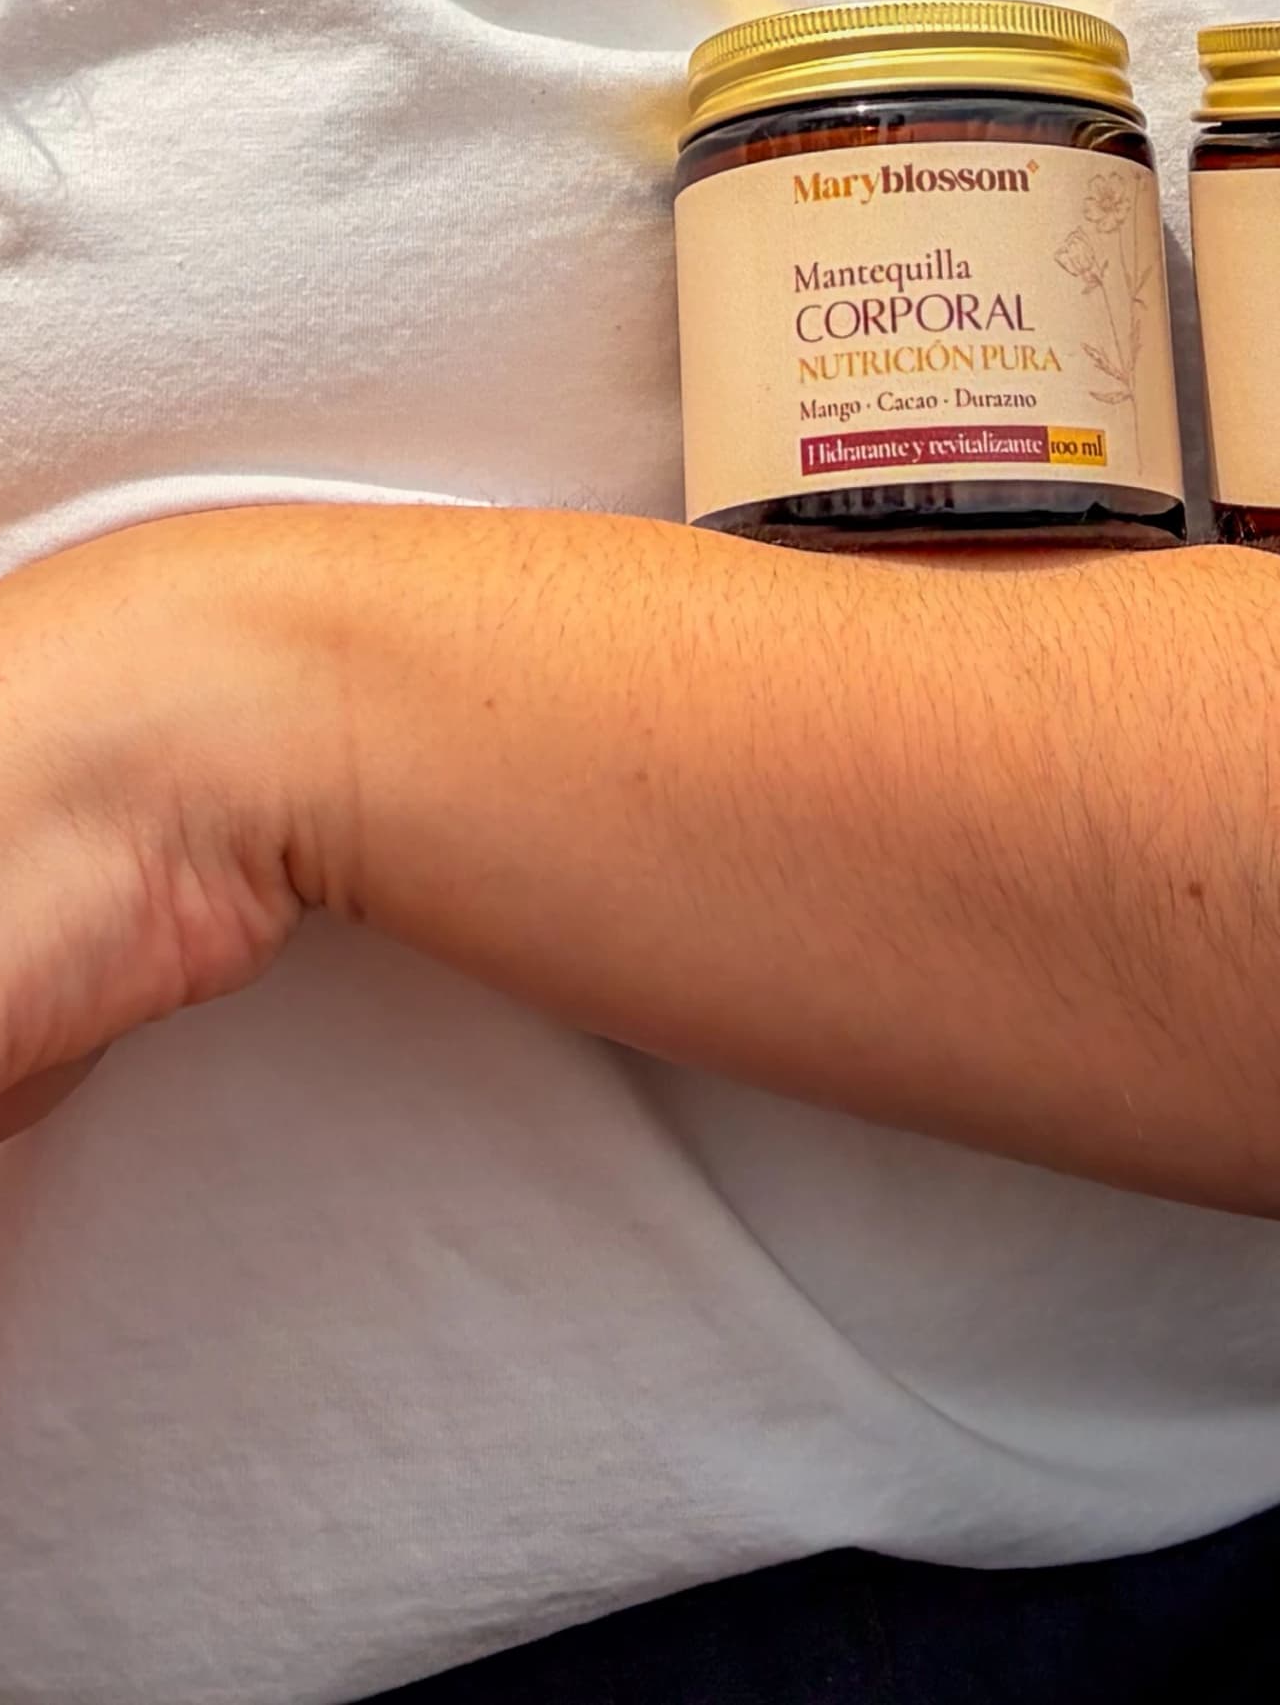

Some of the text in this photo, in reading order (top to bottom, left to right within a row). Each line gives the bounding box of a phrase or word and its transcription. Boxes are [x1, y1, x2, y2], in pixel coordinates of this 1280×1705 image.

[793, 248, 972, 294] Mantequilla
[795, 293, 1036, 344] CORPORAL
[798, 339, 1063, 385] NUTRICIÓN PURA
[799, 387, 1037, 422] Mango Cacao Durazno
[807, 439, 910, 466] Hidratante
[928, 430, 1044, 457] revitalizante
[1051, 441, 1078, 457] 100
[1081, 432, 1105, 458] ml
